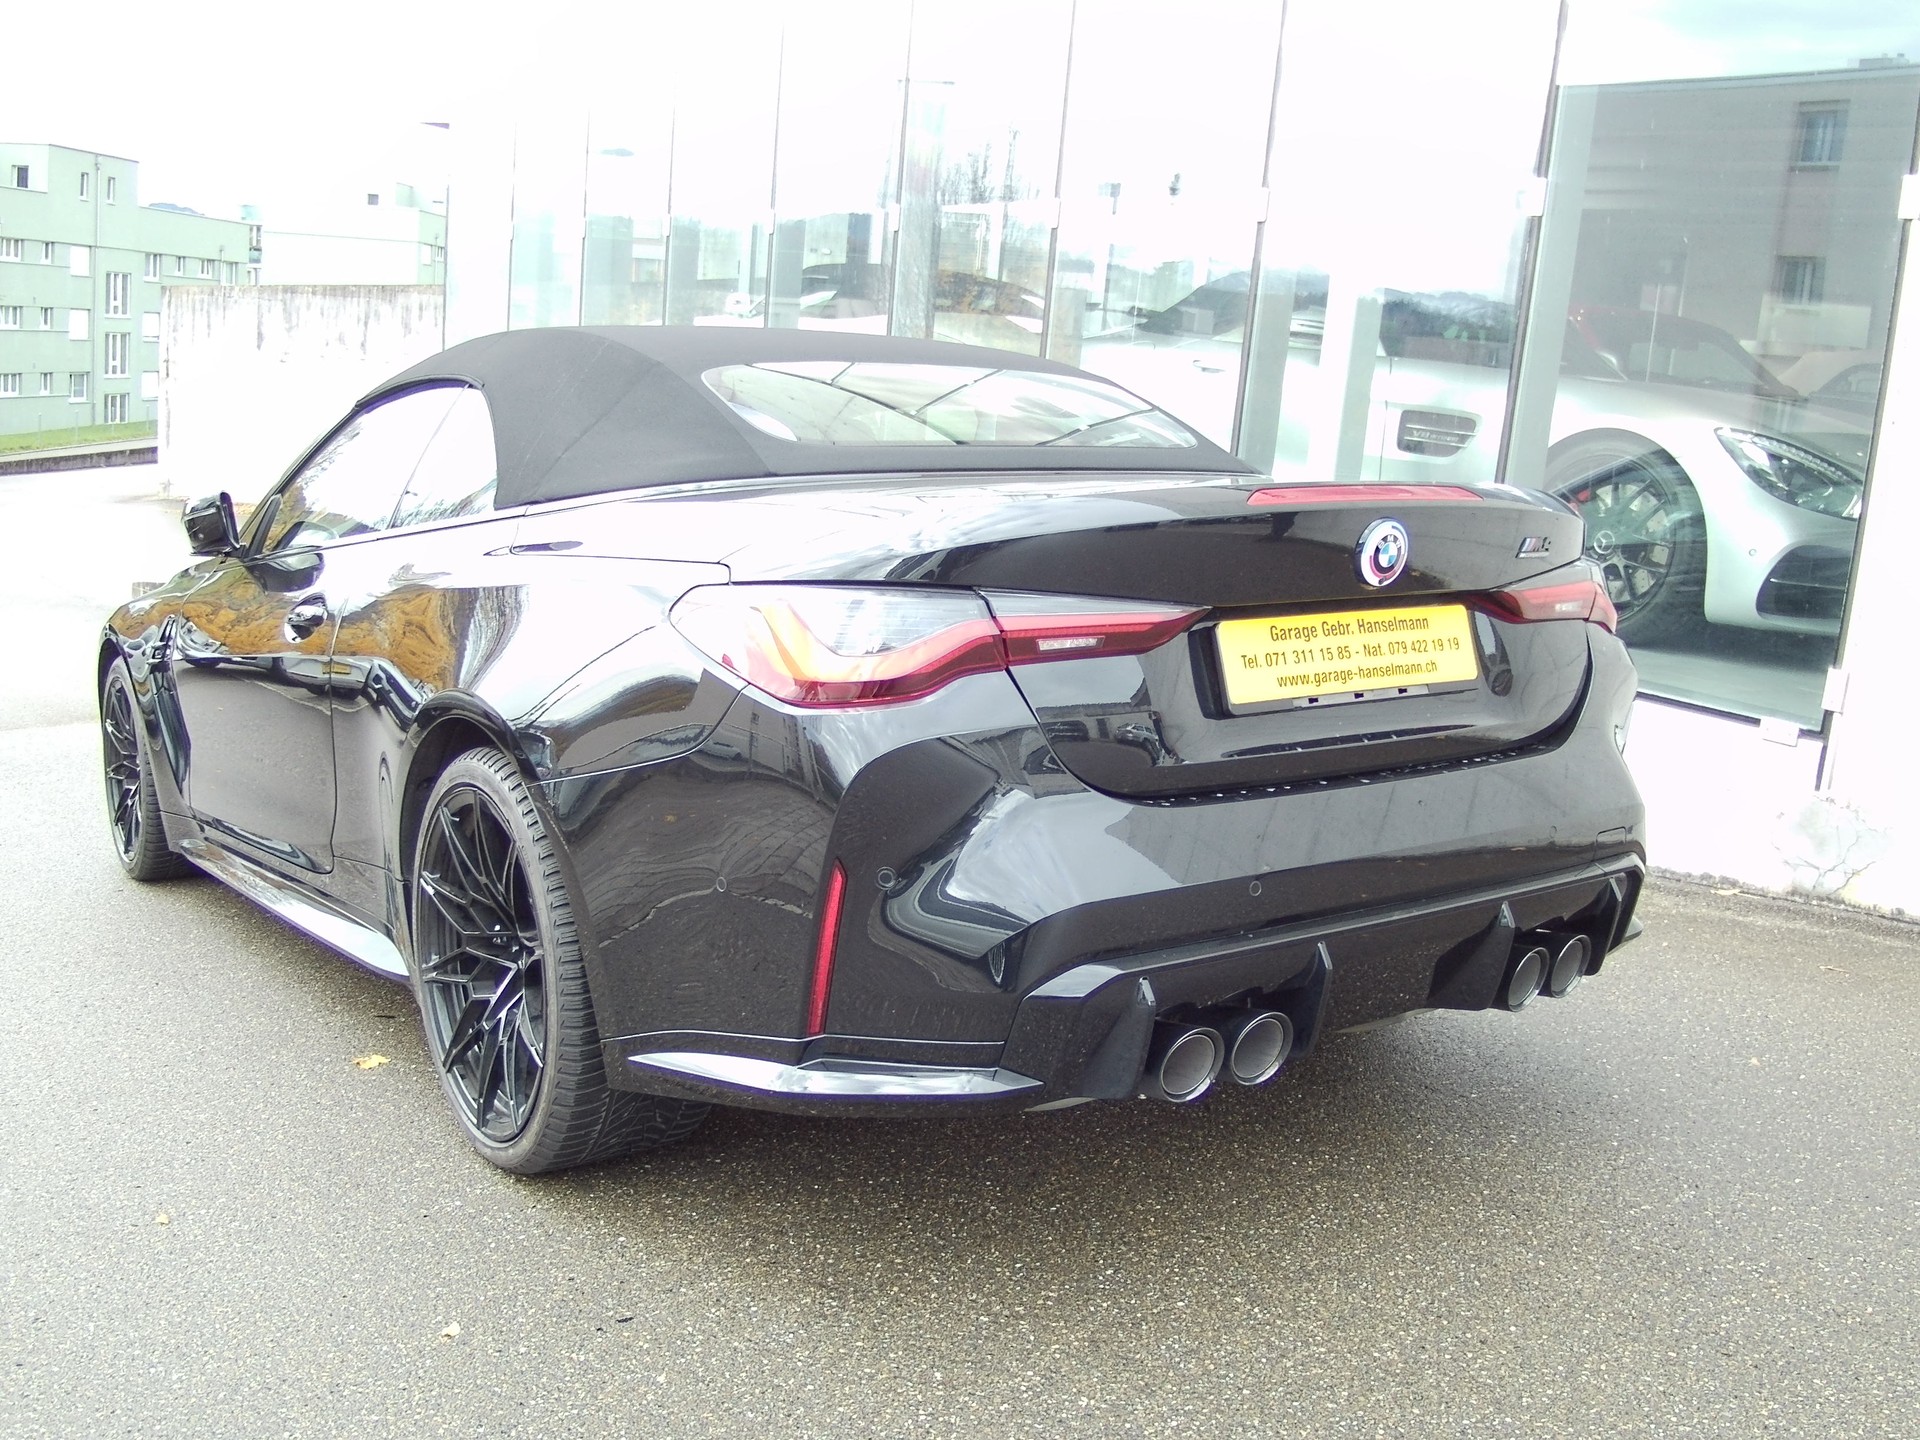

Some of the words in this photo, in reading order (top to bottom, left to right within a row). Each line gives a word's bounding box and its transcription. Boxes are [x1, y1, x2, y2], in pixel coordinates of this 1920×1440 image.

[1377, 533, 1401, 549] BMW
[1270, 625, 1317, 642] Garage
[1322, 620, 1354, 637] Gebr.
[1358, 616, 1429, 634] Hanselmann
[1241, 654, 1262, 669] Tel.
[1265, 652, 1288, 667] 071
[1293, 649, 1315, 664] 311
[1320, 647, 1334, 661] 15
[1337, 646, 1351, 659] 85
[1363, 643, 1386, 657] Nat.
[1389, 641, 1408, 655] 079
[1411, 640, 1428, 653] 422
[1432, 639, 1444, 651] 19
[1447, 637, 1459, 650] 19
[1277, 660, 1438, 687] www.garage-hanselmann.ch
